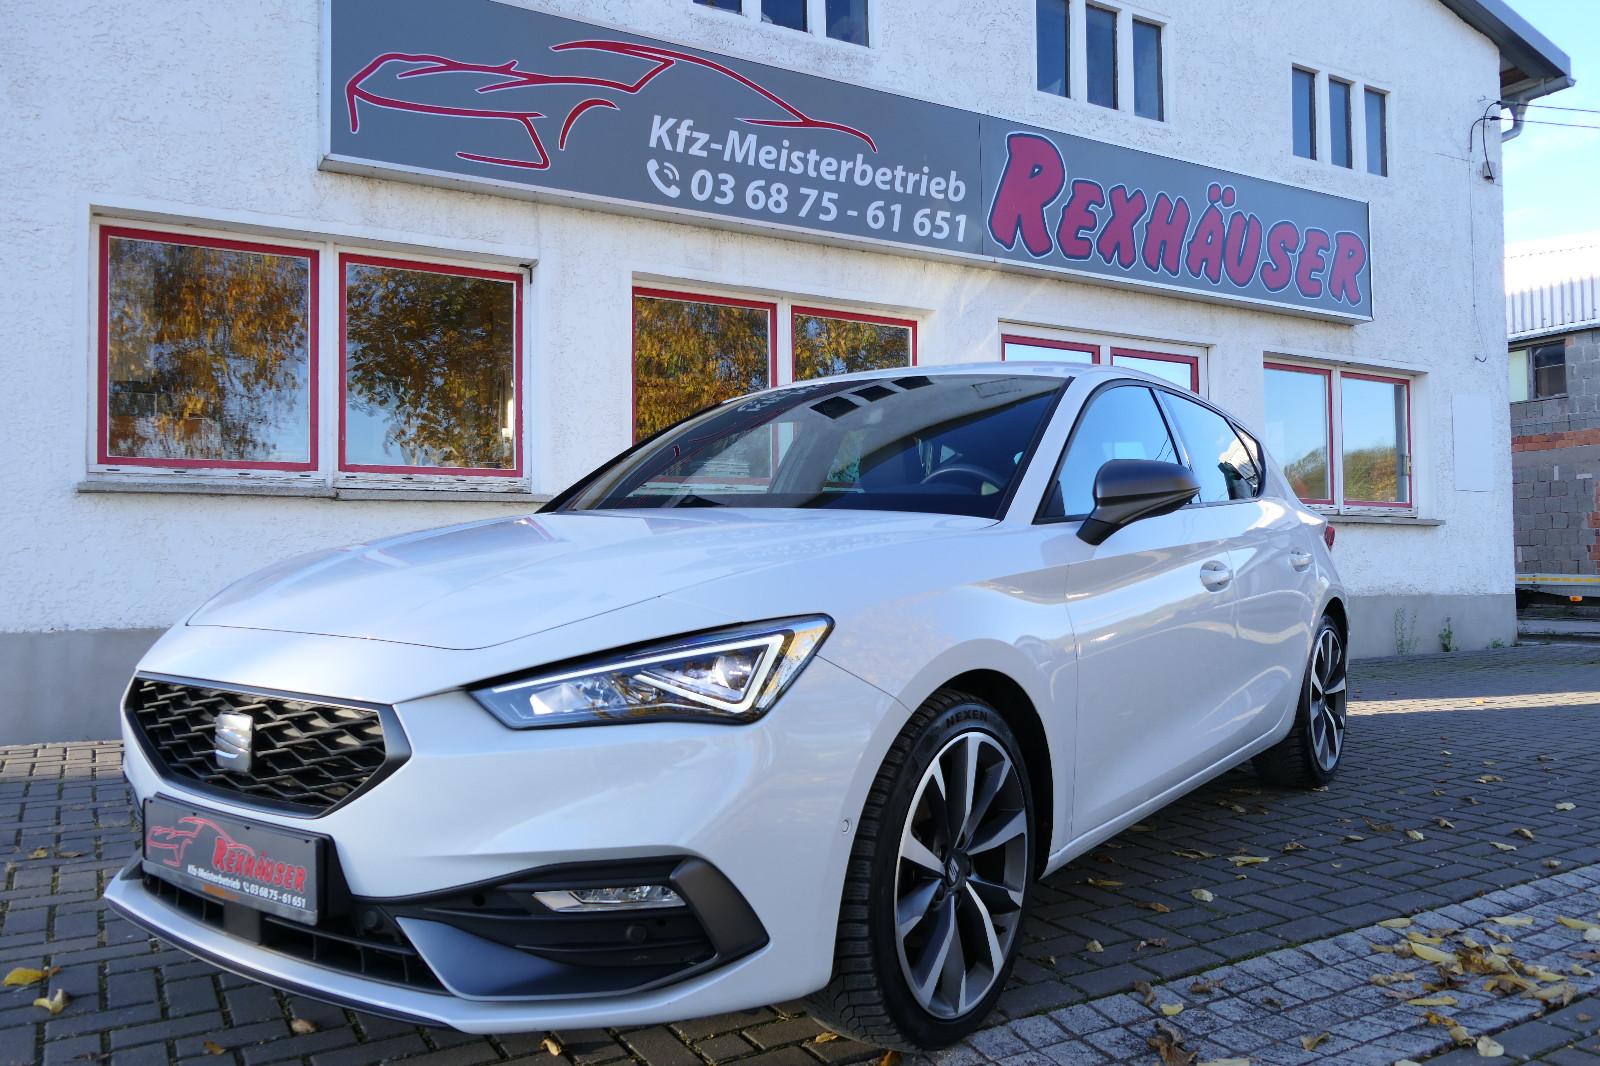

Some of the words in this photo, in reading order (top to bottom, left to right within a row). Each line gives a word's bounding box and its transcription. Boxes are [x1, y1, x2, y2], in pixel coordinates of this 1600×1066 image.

[648, 114, 967, 203] Kfz-Meisterbetrieb
[690, 169, 736, 206] 03
[745, 179, 789, 215] 68
[798, 187, 840, 223] 75
[866, 200, 903, 233] 61
[913, 208, 968, 243] 651
[945, 709, 988, 729] NEXEN
[282, 893, 291, 905] 61
[291, 895, 306, 909] 651
